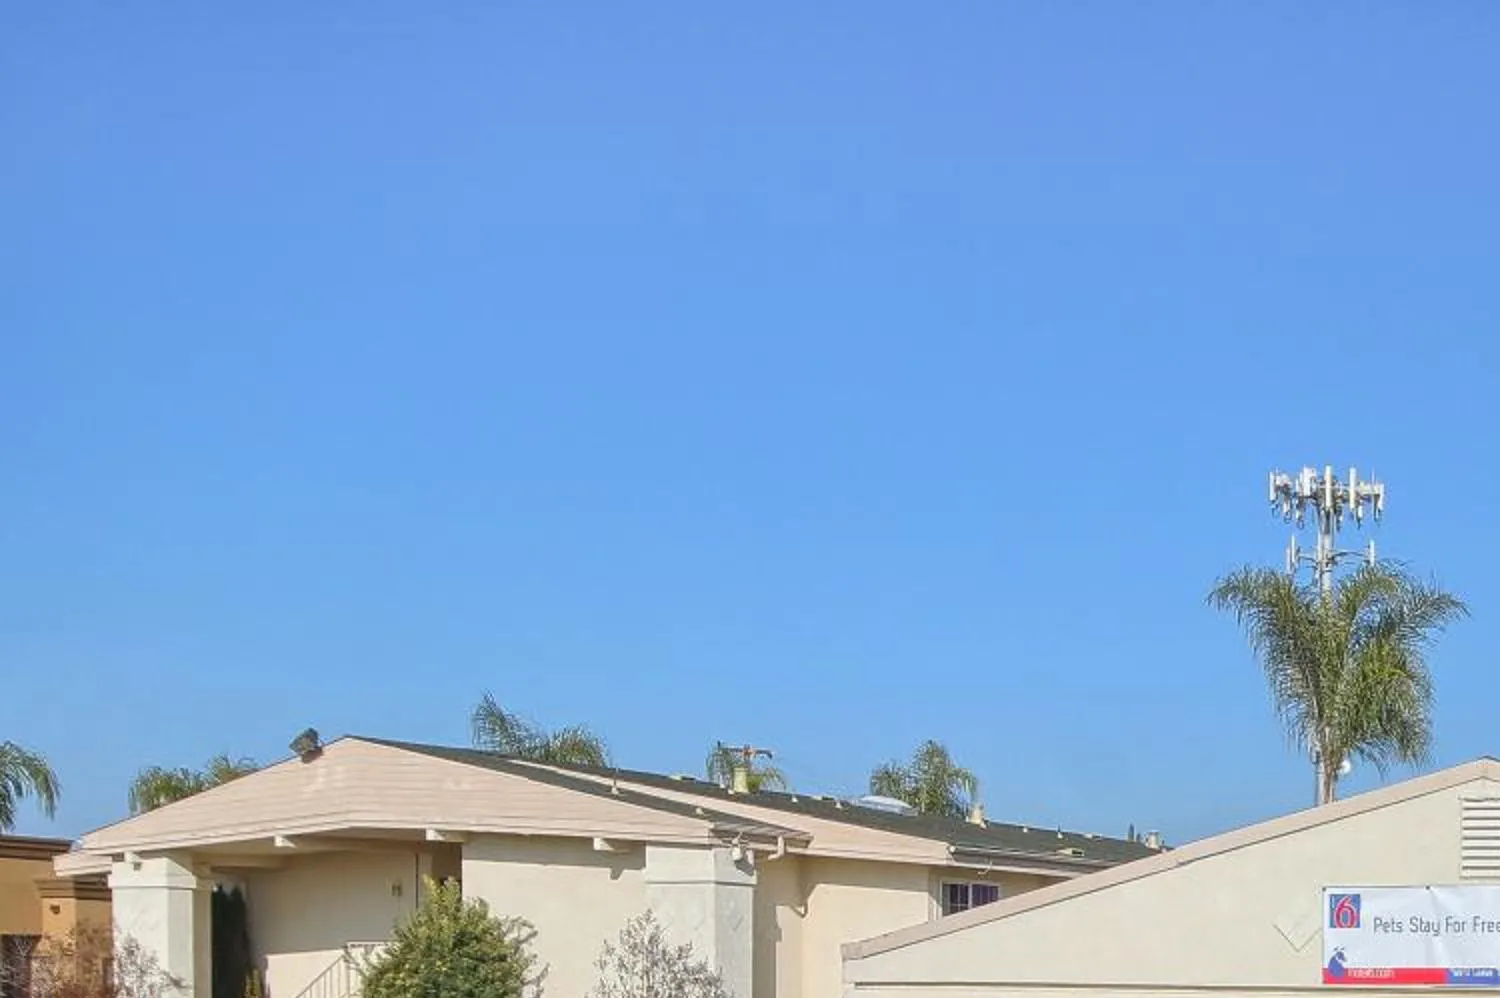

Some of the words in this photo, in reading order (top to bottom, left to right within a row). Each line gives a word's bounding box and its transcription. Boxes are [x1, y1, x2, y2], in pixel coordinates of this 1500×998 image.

[1334, 895, 1357, 928] 6
[1373, 916, 1403, 933] Pets
[1408, 915, 1440, 936] Stay
[1445, 915, 1467, 933] For
